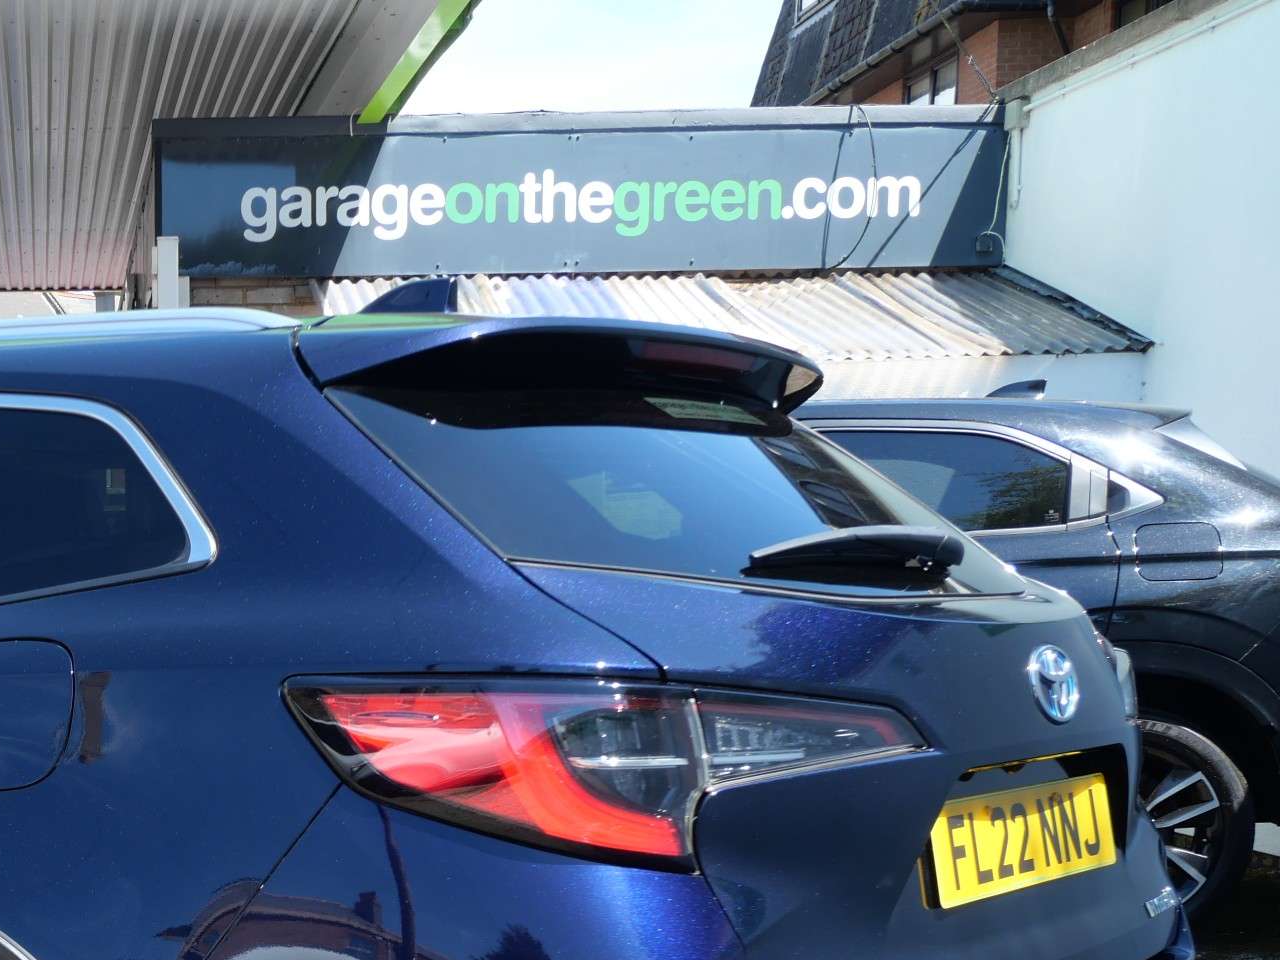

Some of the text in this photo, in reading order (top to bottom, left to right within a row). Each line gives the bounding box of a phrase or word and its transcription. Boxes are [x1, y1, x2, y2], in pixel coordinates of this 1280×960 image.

[240, 168, 921, 243] garageonthegreen.com
[947, 788, 1101, 891] FL22 NNJ
